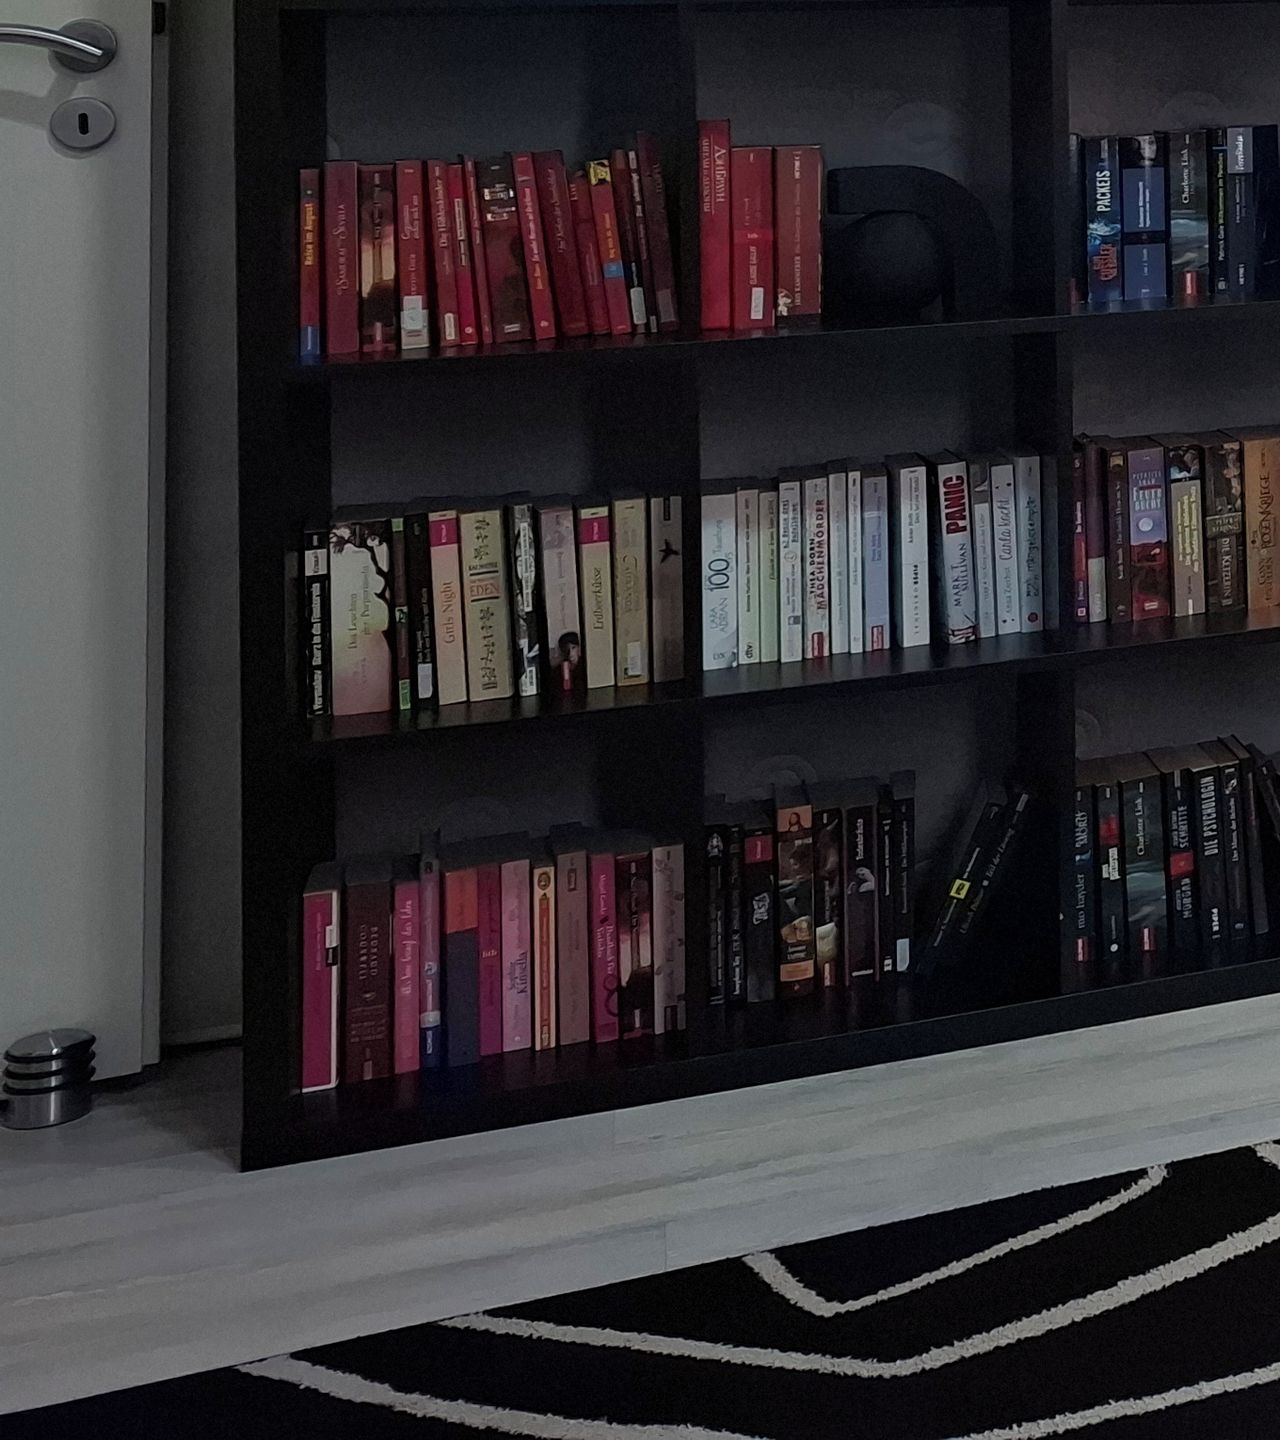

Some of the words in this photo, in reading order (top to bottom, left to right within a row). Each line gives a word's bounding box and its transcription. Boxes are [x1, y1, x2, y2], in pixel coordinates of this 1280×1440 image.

[1180, 148, 1189, 166] Link
[1095, 170, 1112, 212] PACKEIS
[1181, 167, 1190, 204] Charlotte
[303, 203, 316, 231] August
[438, 232, 448, 247] Die
[943, 475, 967, 534] PANIC
[815, 499, 827, 610] MÄDCHENMÖRDER
[1222, 537, 1230, 553] DIE
[707, 558, 730, 592] 100
[958, 543, 968, 591] SULLIVAN
[440, 581, 454, 614] Night
[592, 567, 604, 630] Erdbeerküsse
[952, 576, 962, 607] MARK
[442, 616, 456, 644] Girls
[745, 643, 753, 659] dtv
[1135, 797, 1143, 816] Link
[1200, 776, 1218, 836] PSYCHOLOGIN
[1136, 817, 1145, 856] Charlotte
[1204, 838, 1218, 856] DIE
[1076, 874, 1087, 909] hayder
[1077, 910, 1086, 929] mo
[516, 951, 528, 994] Kinsella
